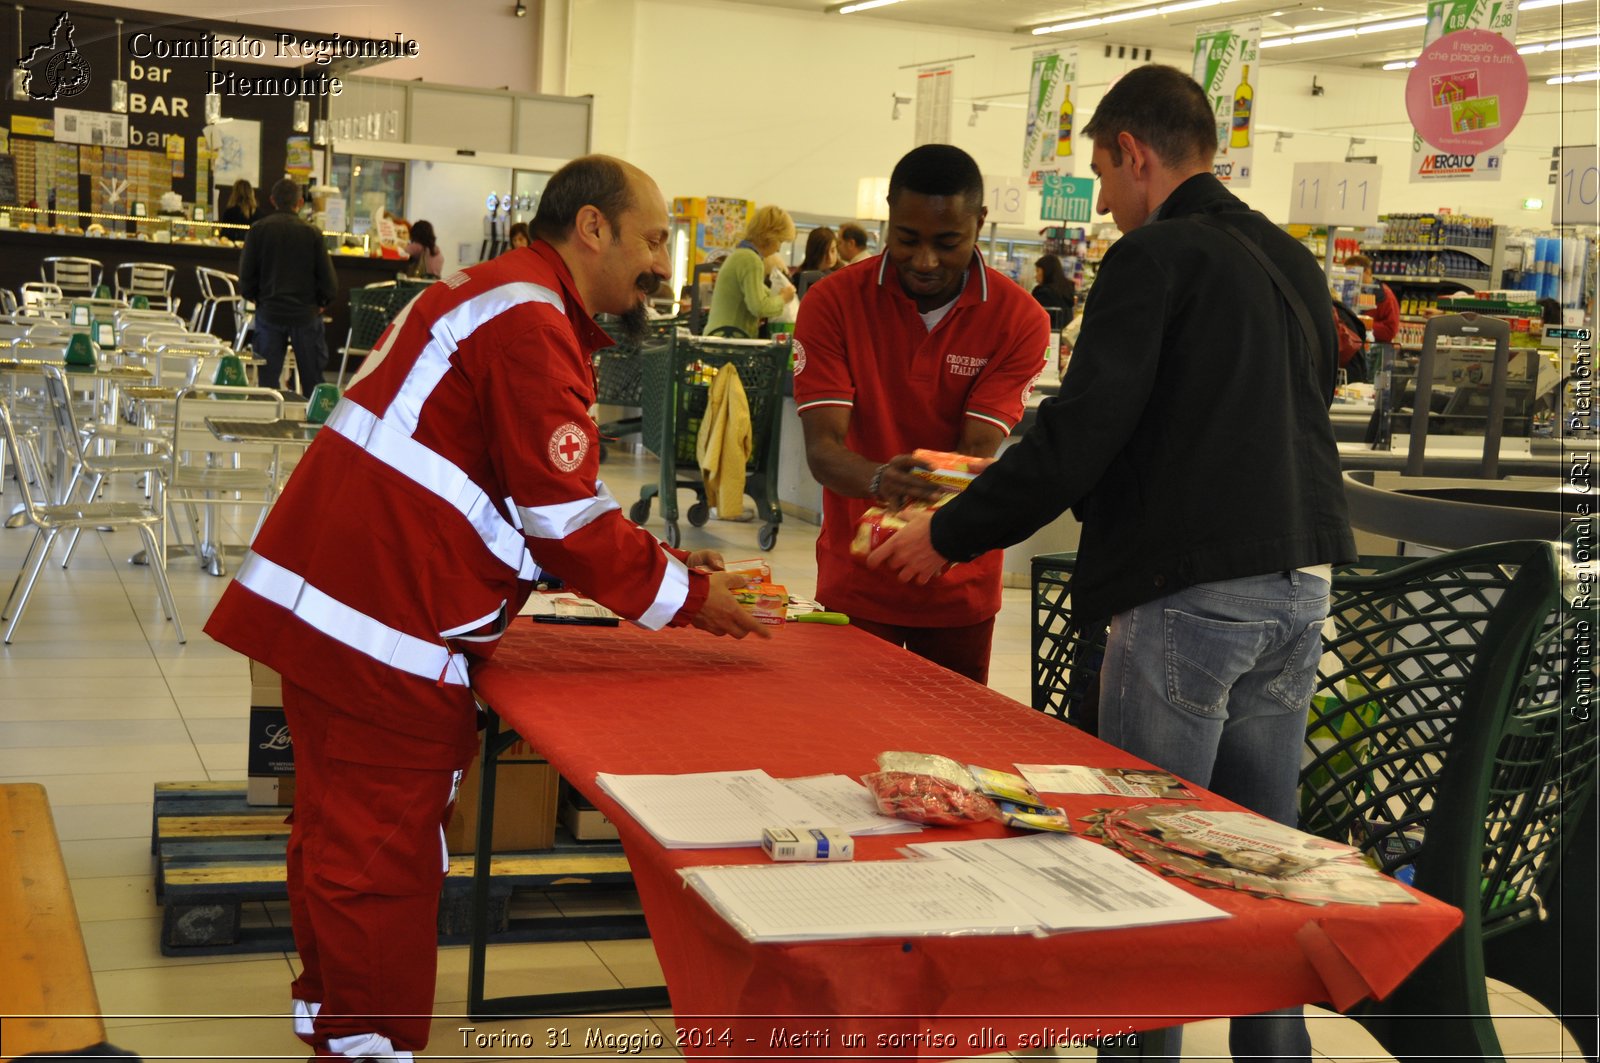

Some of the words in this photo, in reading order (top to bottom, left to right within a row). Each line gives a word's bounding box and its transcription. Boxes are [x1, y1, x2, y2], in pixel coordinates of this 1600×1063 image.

[1428, 51, 1449, 61] che
[1450, 53, 1481, 63] piace
[1482, 55, 1491, 63] a
[1460, 42, 1494, 54] regalo
[129, 60, 172, 83] bar
[129, 95, 189, 118] BAR
[129, 126, 168, 147] bar
[1299, 179, 1320, 209] 11
[1338, 179, 1368, 212] 11
[1563, 167, 1600, 205] 10
[991, 187, 1021, 213] 13
[946, 354, 970, 367] CROCE
